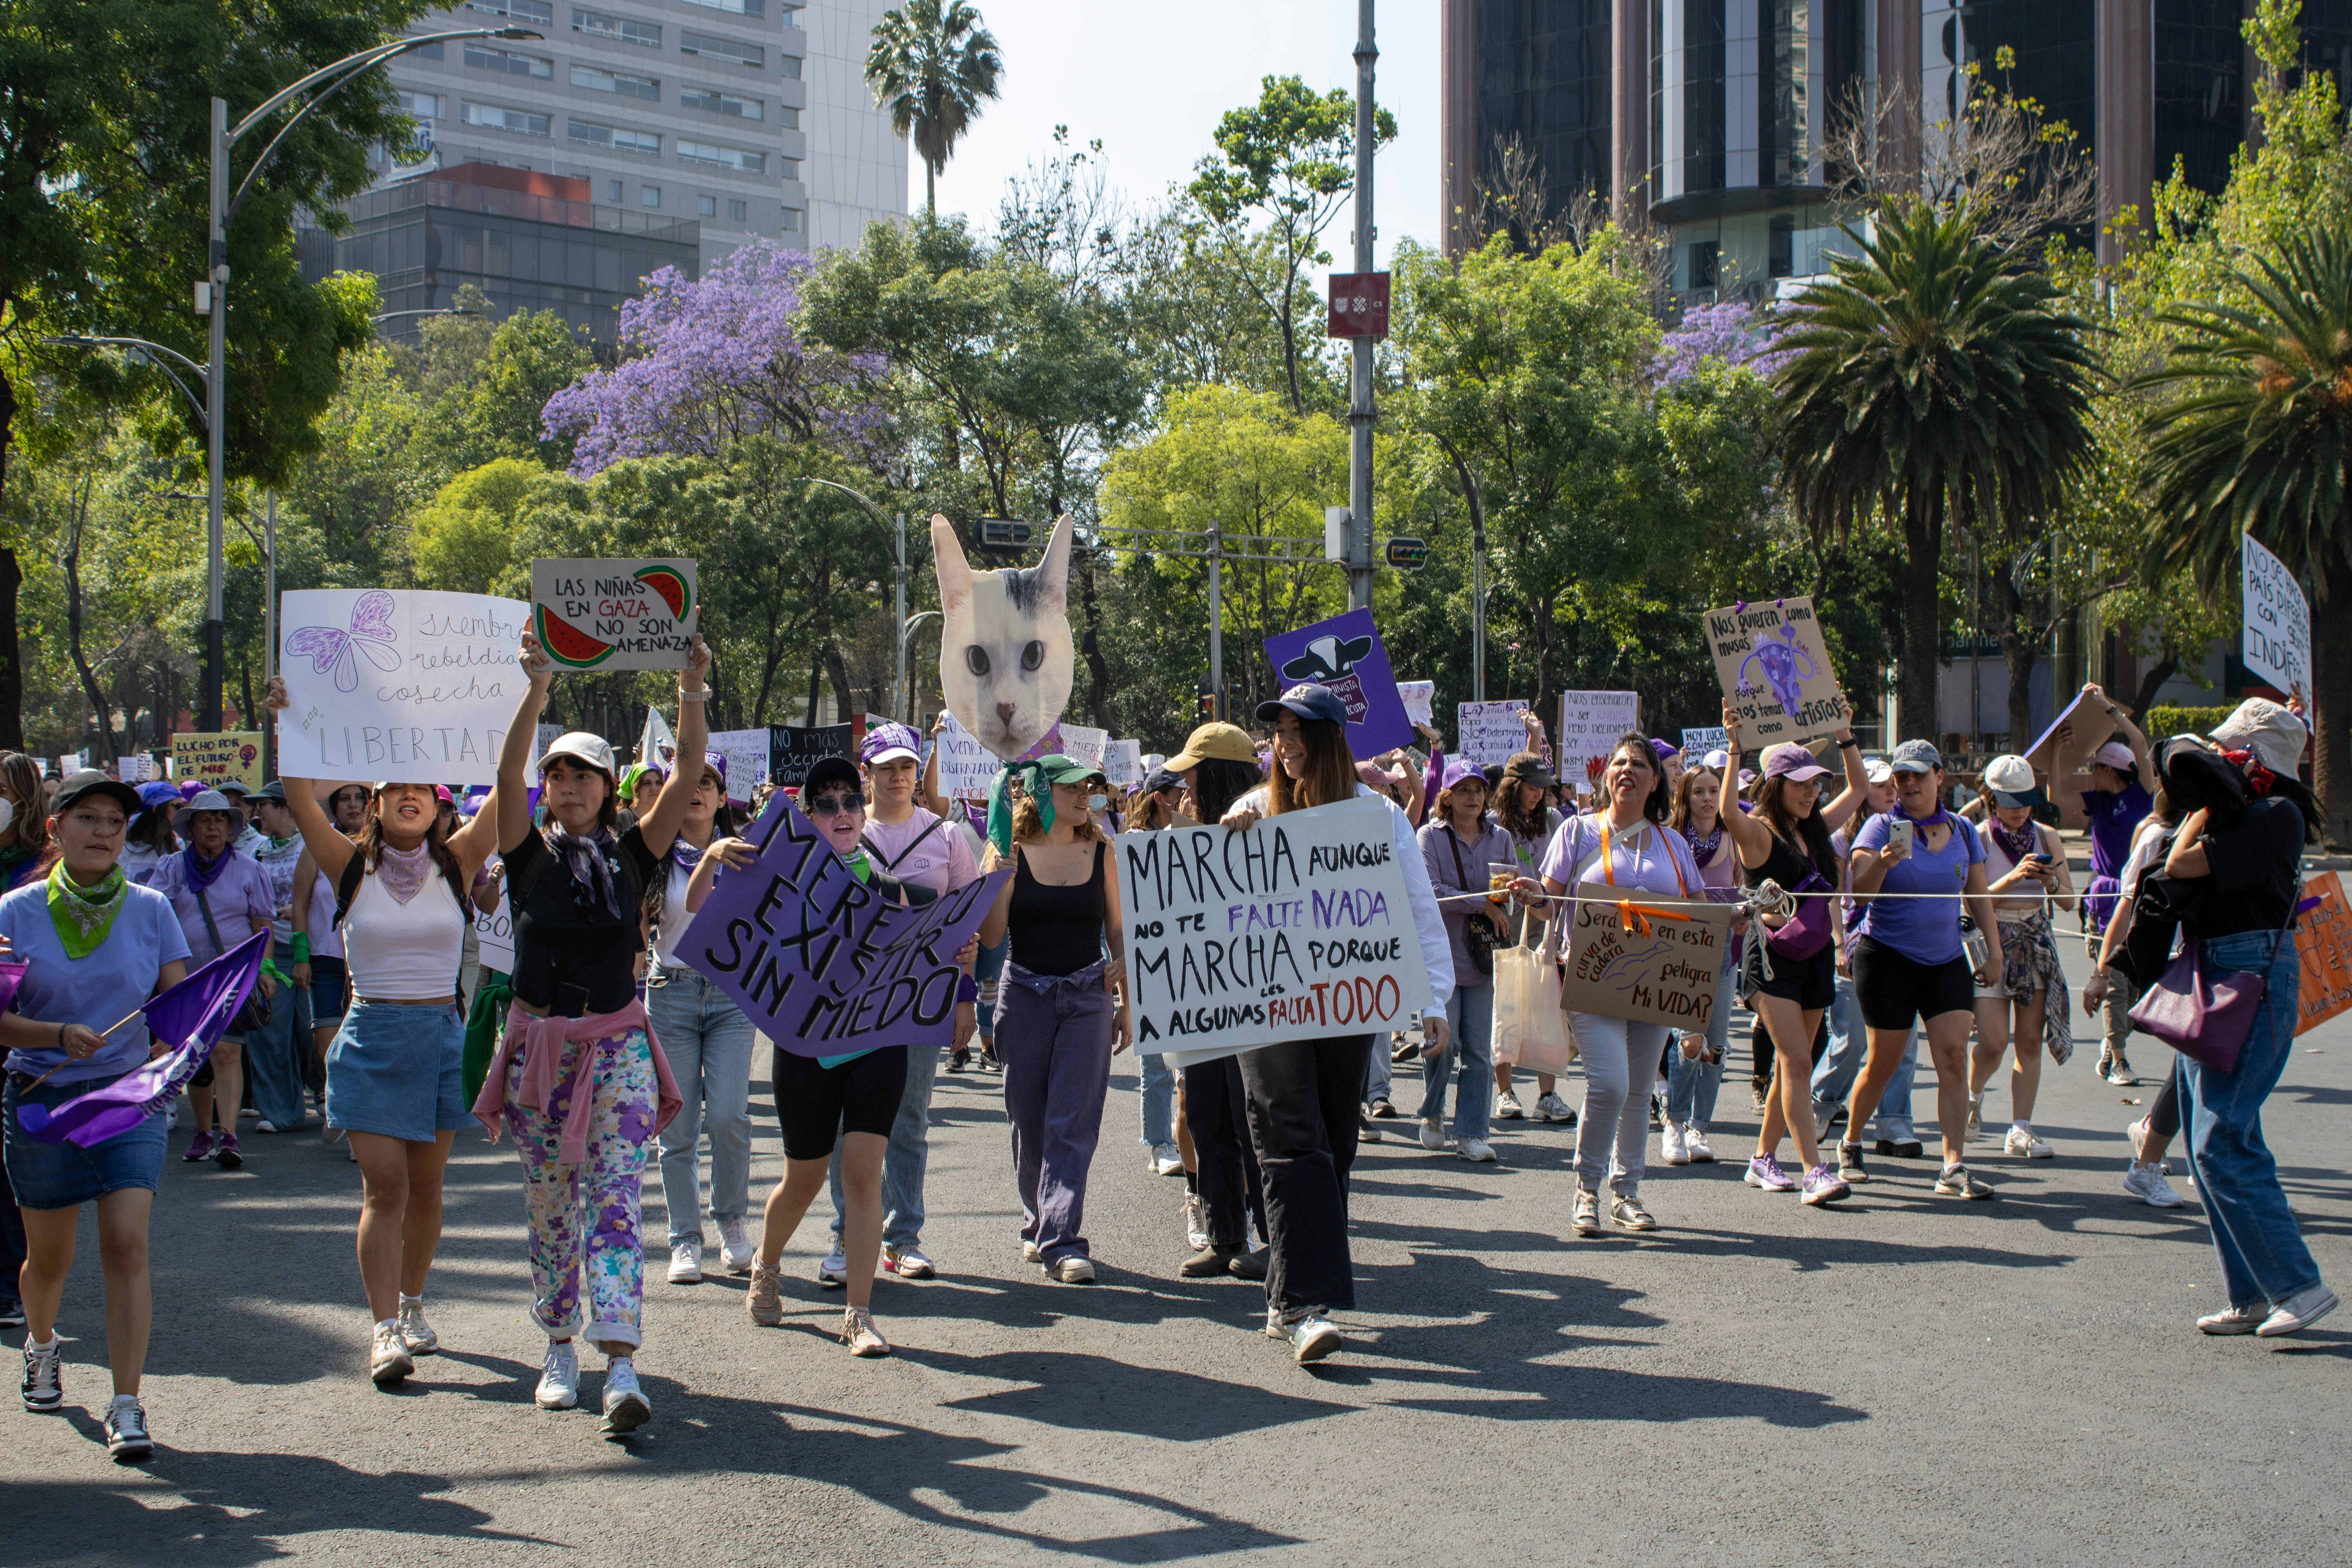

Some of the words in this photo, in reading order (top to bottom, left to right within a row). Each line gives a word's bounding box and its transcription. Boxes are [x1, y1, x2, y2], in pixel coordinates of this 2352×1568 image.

[2247, 540, 2267, 573] NO
[556, 578, 585, 596] LAS
[595, 576, 646, 598] NIÑAS
[565, 601, 590, 617] EN
[599, 599, 650, 618] GAZA
[595, 619, 624, 636] NO
[638, 619, 673, 635] SON
[1710, 615, 1736, 639] Nos
[1739, 608, 1781, 635] quieren
[1786, 607, 1811, 621] como
[616, 636, 693, 653] AMENAZA
[1718, 637, 1751, 657] musas
[377, 676, 504, 704] cosecha
[1327, 680, 1358, 694] MINISTA
[1735, 684, 1764, 702] porque
[1340, 694, 1352, 702] NTI
[1346, 702, 1366, 715] ECISTA
[1461, 719, 1481, 728] ropa
[1757, 721, 1782, 734] como
[774, 729, 791, 748] NO
[804, 729, 838, 749] más
[1461, 727, 1481, 739] NO
[1686, 730, 1702, 742] HOY
[176, 740, 215, 752] LUCHO
[218, 738, 240, 748] POR
[1073, 740, 1103, 753] MIEDO
[1584, 737, 1616, 751] ALIADA
[1686, 741, 1703, 750] CON
[178, 755, 193, 764] EL
[195, 753, 234, 763] FUTURO
[1563, 755, 1583, 766] #8M
[181, 766, 194, 776] DE
[200, 764, 227, 774] MIS
[953, 787, 990, 800] AMOR
[1127, 826, 1299, 913] MARCHA
[1308, 841, 1390, 876] AUNQUE
[1134, 920, 1164, 939] NO
[1176, 912, 1206, 934] TE
[1228, 899, 1303, 933] FALTE
[1311, 887, 1390, 929] NADA
[1577, 902, 1619, 928] Será
[1657, 925, 1676, 940] en
[1682, 927, 1715, 947] esta
[1481, 933, 1495, 942] MK
[1576, 941, 1601, 979] curva
[1601, 930, 1617, 947] de
[1589, 944, 1625, 982] cadera
[1135, 929, 1304, 1005] MARCHA
[1307, 937, 1402, 972] PORQUE
[1659, 959, 1711, 988] peligra
[706, 918, 796, 1018] SIN
[796, 965, 961, 1042] MIEDO
[1260, 983, 1285, 998] LES
[1309, 973, 1400, 1026] TODO
[1269, 996, 1315, 1030] FALTA
[1632, 984, 1652, 1008] Mi
[1657, 988, 1713, 1024] VIDA?
[1139, 1014, 1160, 1044] A
[1169, 1003, 1266, 1037] ALGUNAS
